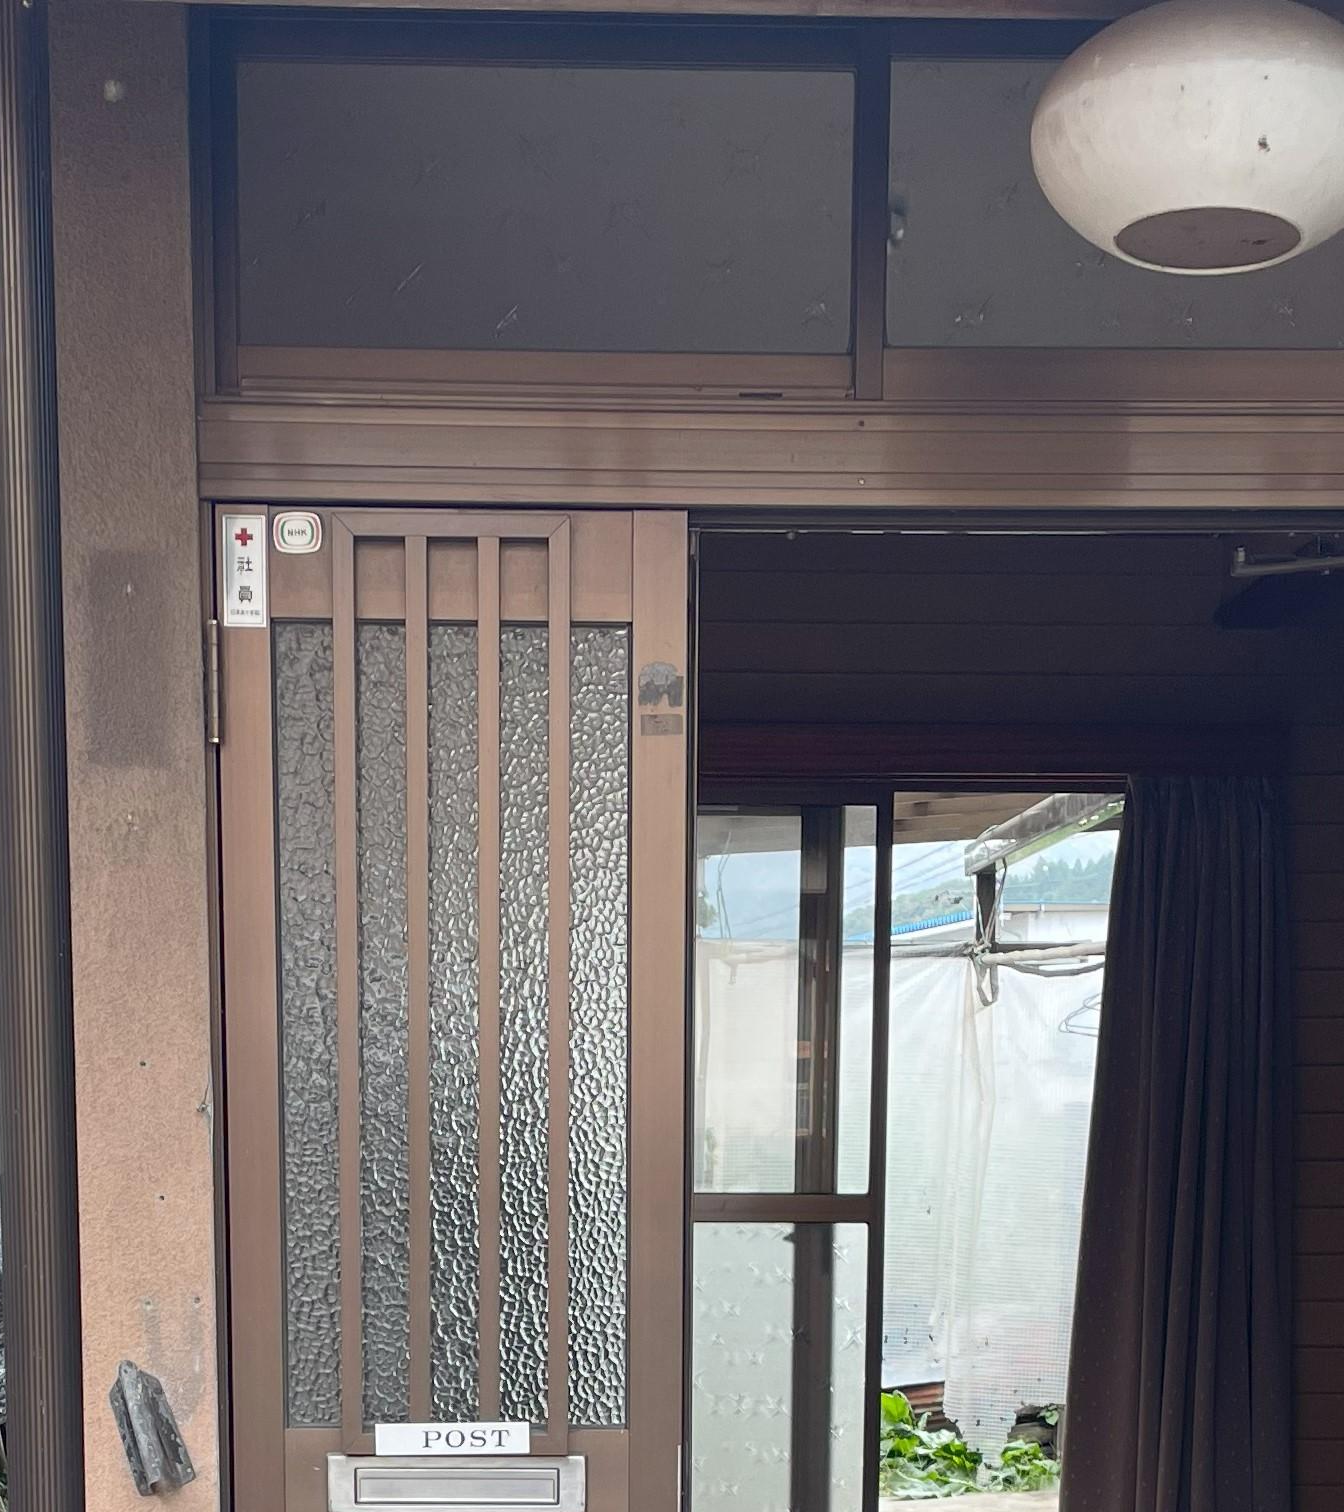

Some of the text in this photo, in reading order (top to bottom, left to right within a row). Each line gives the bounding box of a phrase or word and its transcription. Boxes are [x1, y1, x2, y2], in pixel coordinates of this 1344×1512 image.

[287, 529, 308, 537] NHK
[236, 556, 254, 605] 社員
[422, 1429, 512, 1449] POST
